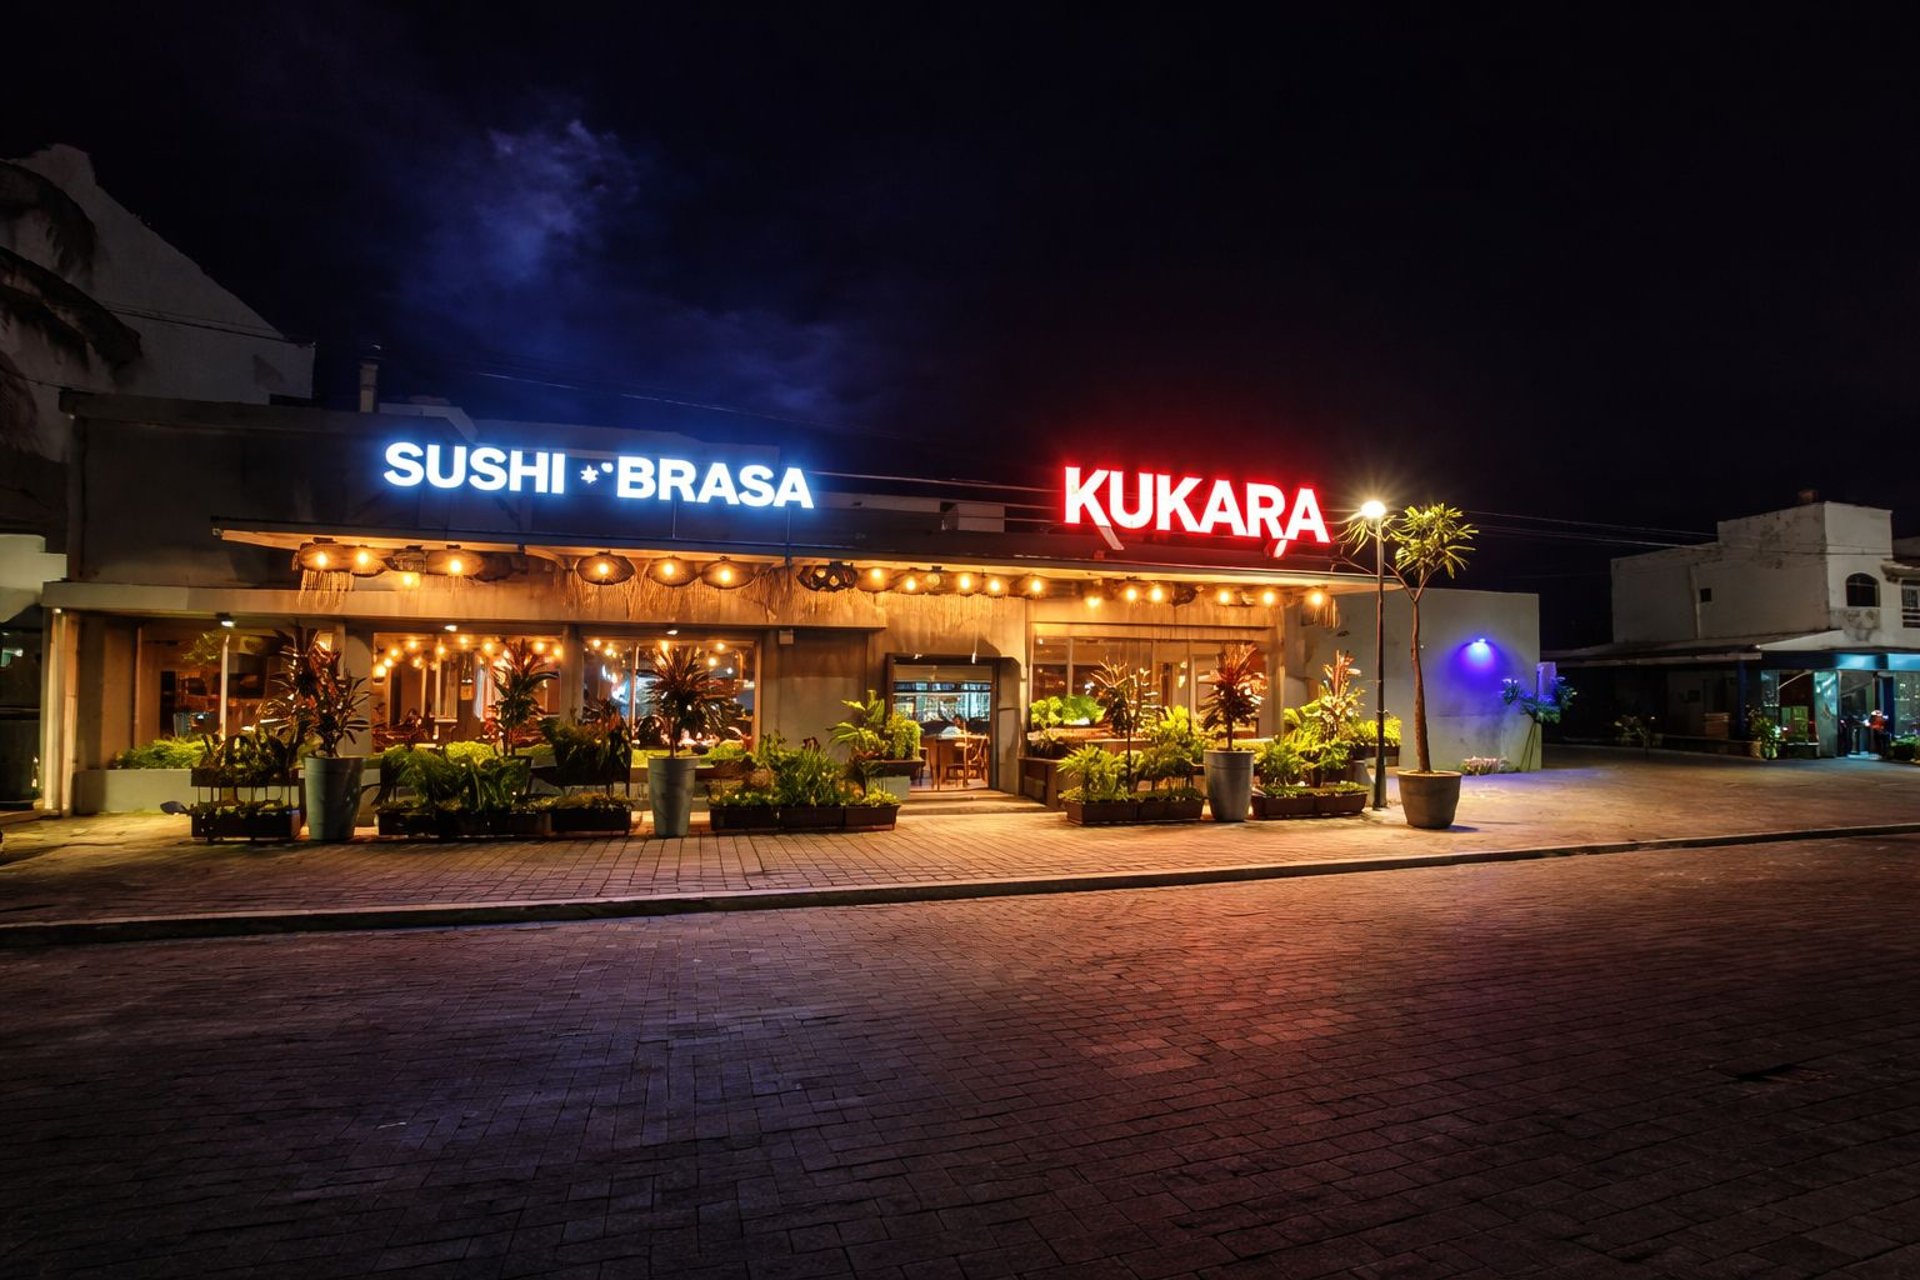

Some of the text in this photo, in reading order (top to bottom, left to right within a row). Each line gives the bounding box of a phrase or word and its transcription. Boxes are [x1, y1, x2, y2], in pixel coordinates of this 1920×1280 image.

[384, 441, 814, 509] SUSHI BRASA
[1065, 466, 1330, 557] KUKARA
